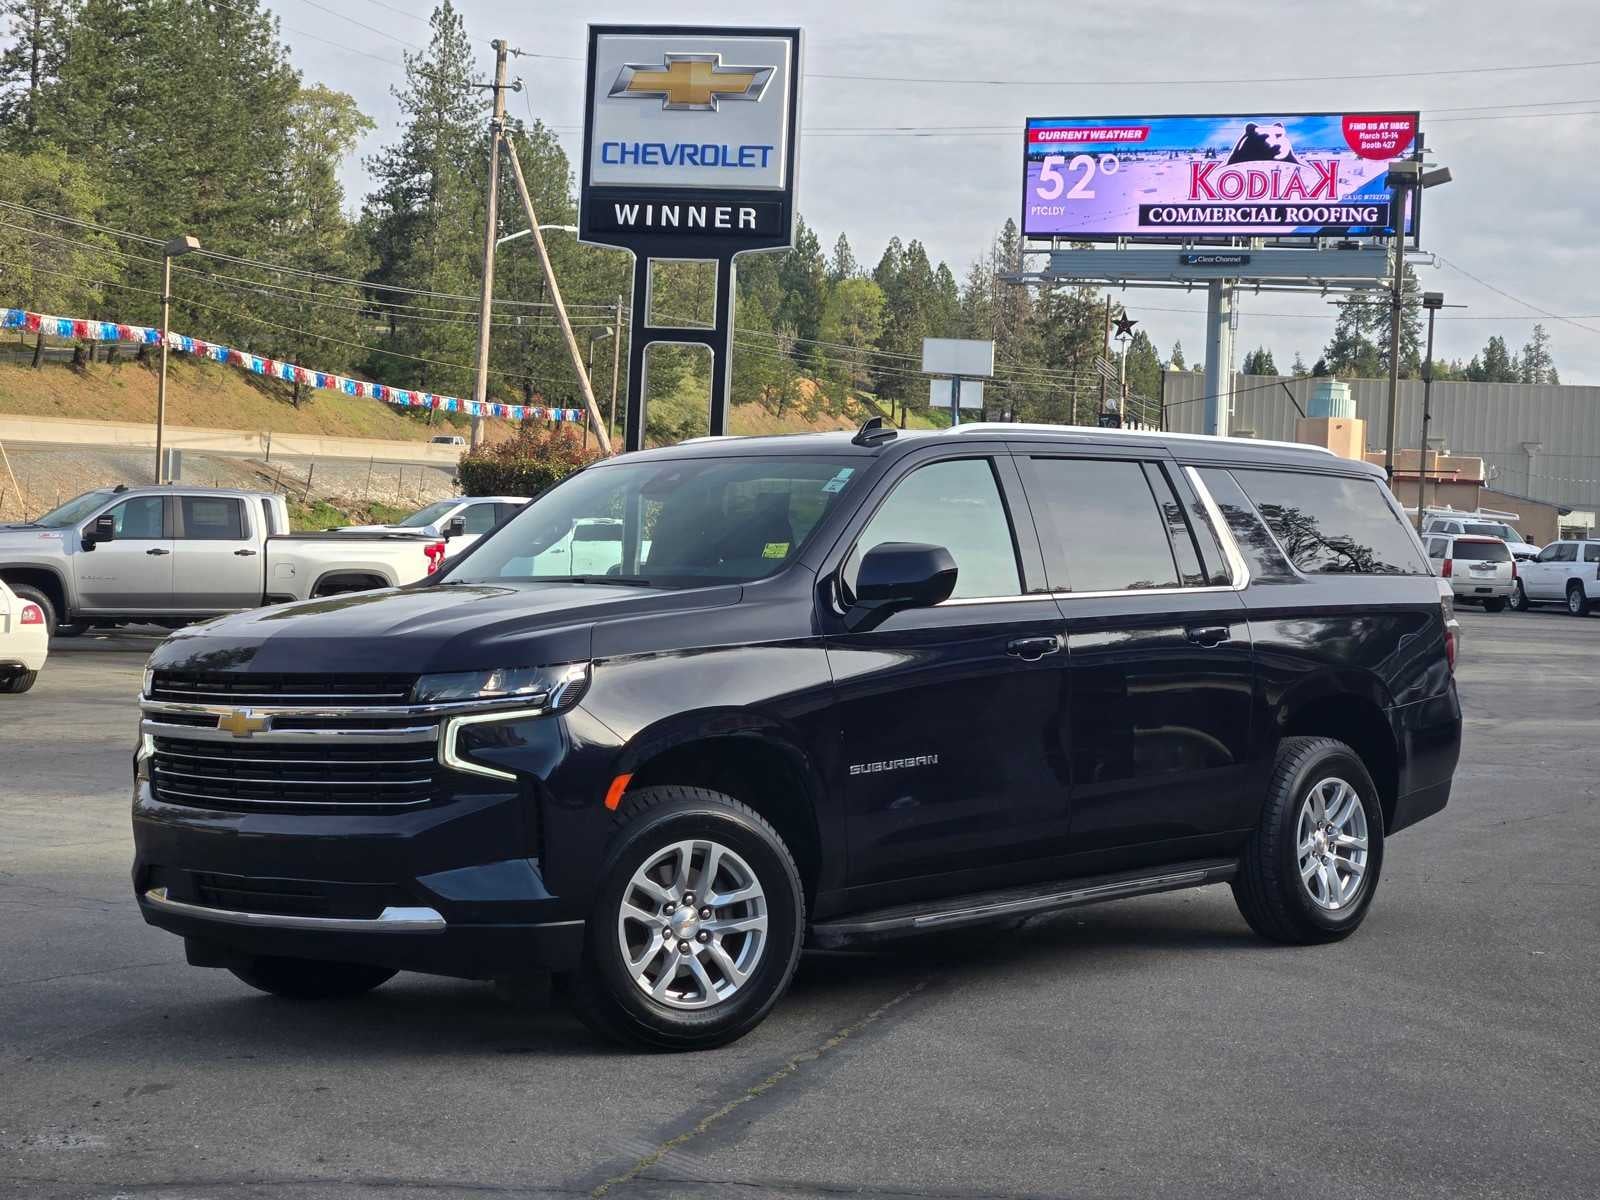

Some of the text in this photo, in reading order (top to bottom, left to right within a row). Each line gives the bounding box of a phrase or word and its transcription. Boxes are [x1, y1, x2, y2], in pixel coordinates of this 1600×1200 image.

[1349, 122, 1367, 130] FIND
[1367, 122, 1379, 130] US
[1379, 122, 1390, 130] AT
[1038, 129, 1143, 140] CURRENT WEATHER
[1360, 131, 1381, 140] March
[1361, 141, 1382, 149] Booth
[602, 142, 774, 168] CHEVROLET
[1188, 160, 1340, 201] KODIAK
[614, 203, 757, 229] WINNER
[1031, 206, 1065, 216] PTCLDY
[1148, 206, 1379, 223] COMMERCIAL ROOFING
[1215, 255, 1241, 263] Channel
[849, 754, 938, 775] SUBURBAN
